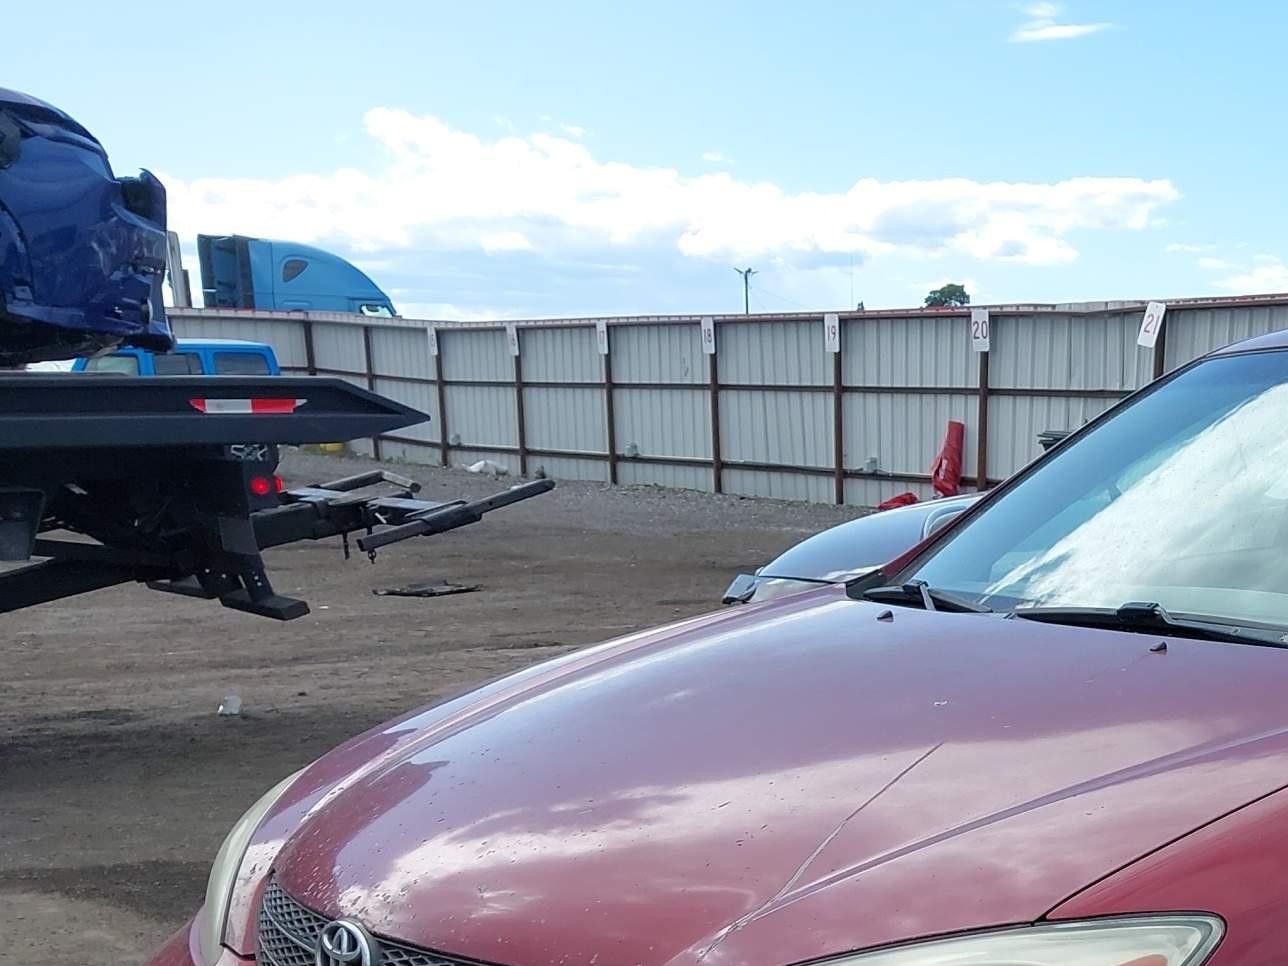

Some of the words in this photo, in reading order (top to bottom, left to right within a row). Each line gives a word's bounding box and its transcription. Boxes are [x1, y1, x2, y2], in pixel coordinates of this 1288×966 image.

[827, 324, 836, 341] 19
[973, 320, 988, 339] 20
[1143, 313, 1160, 335] 21
